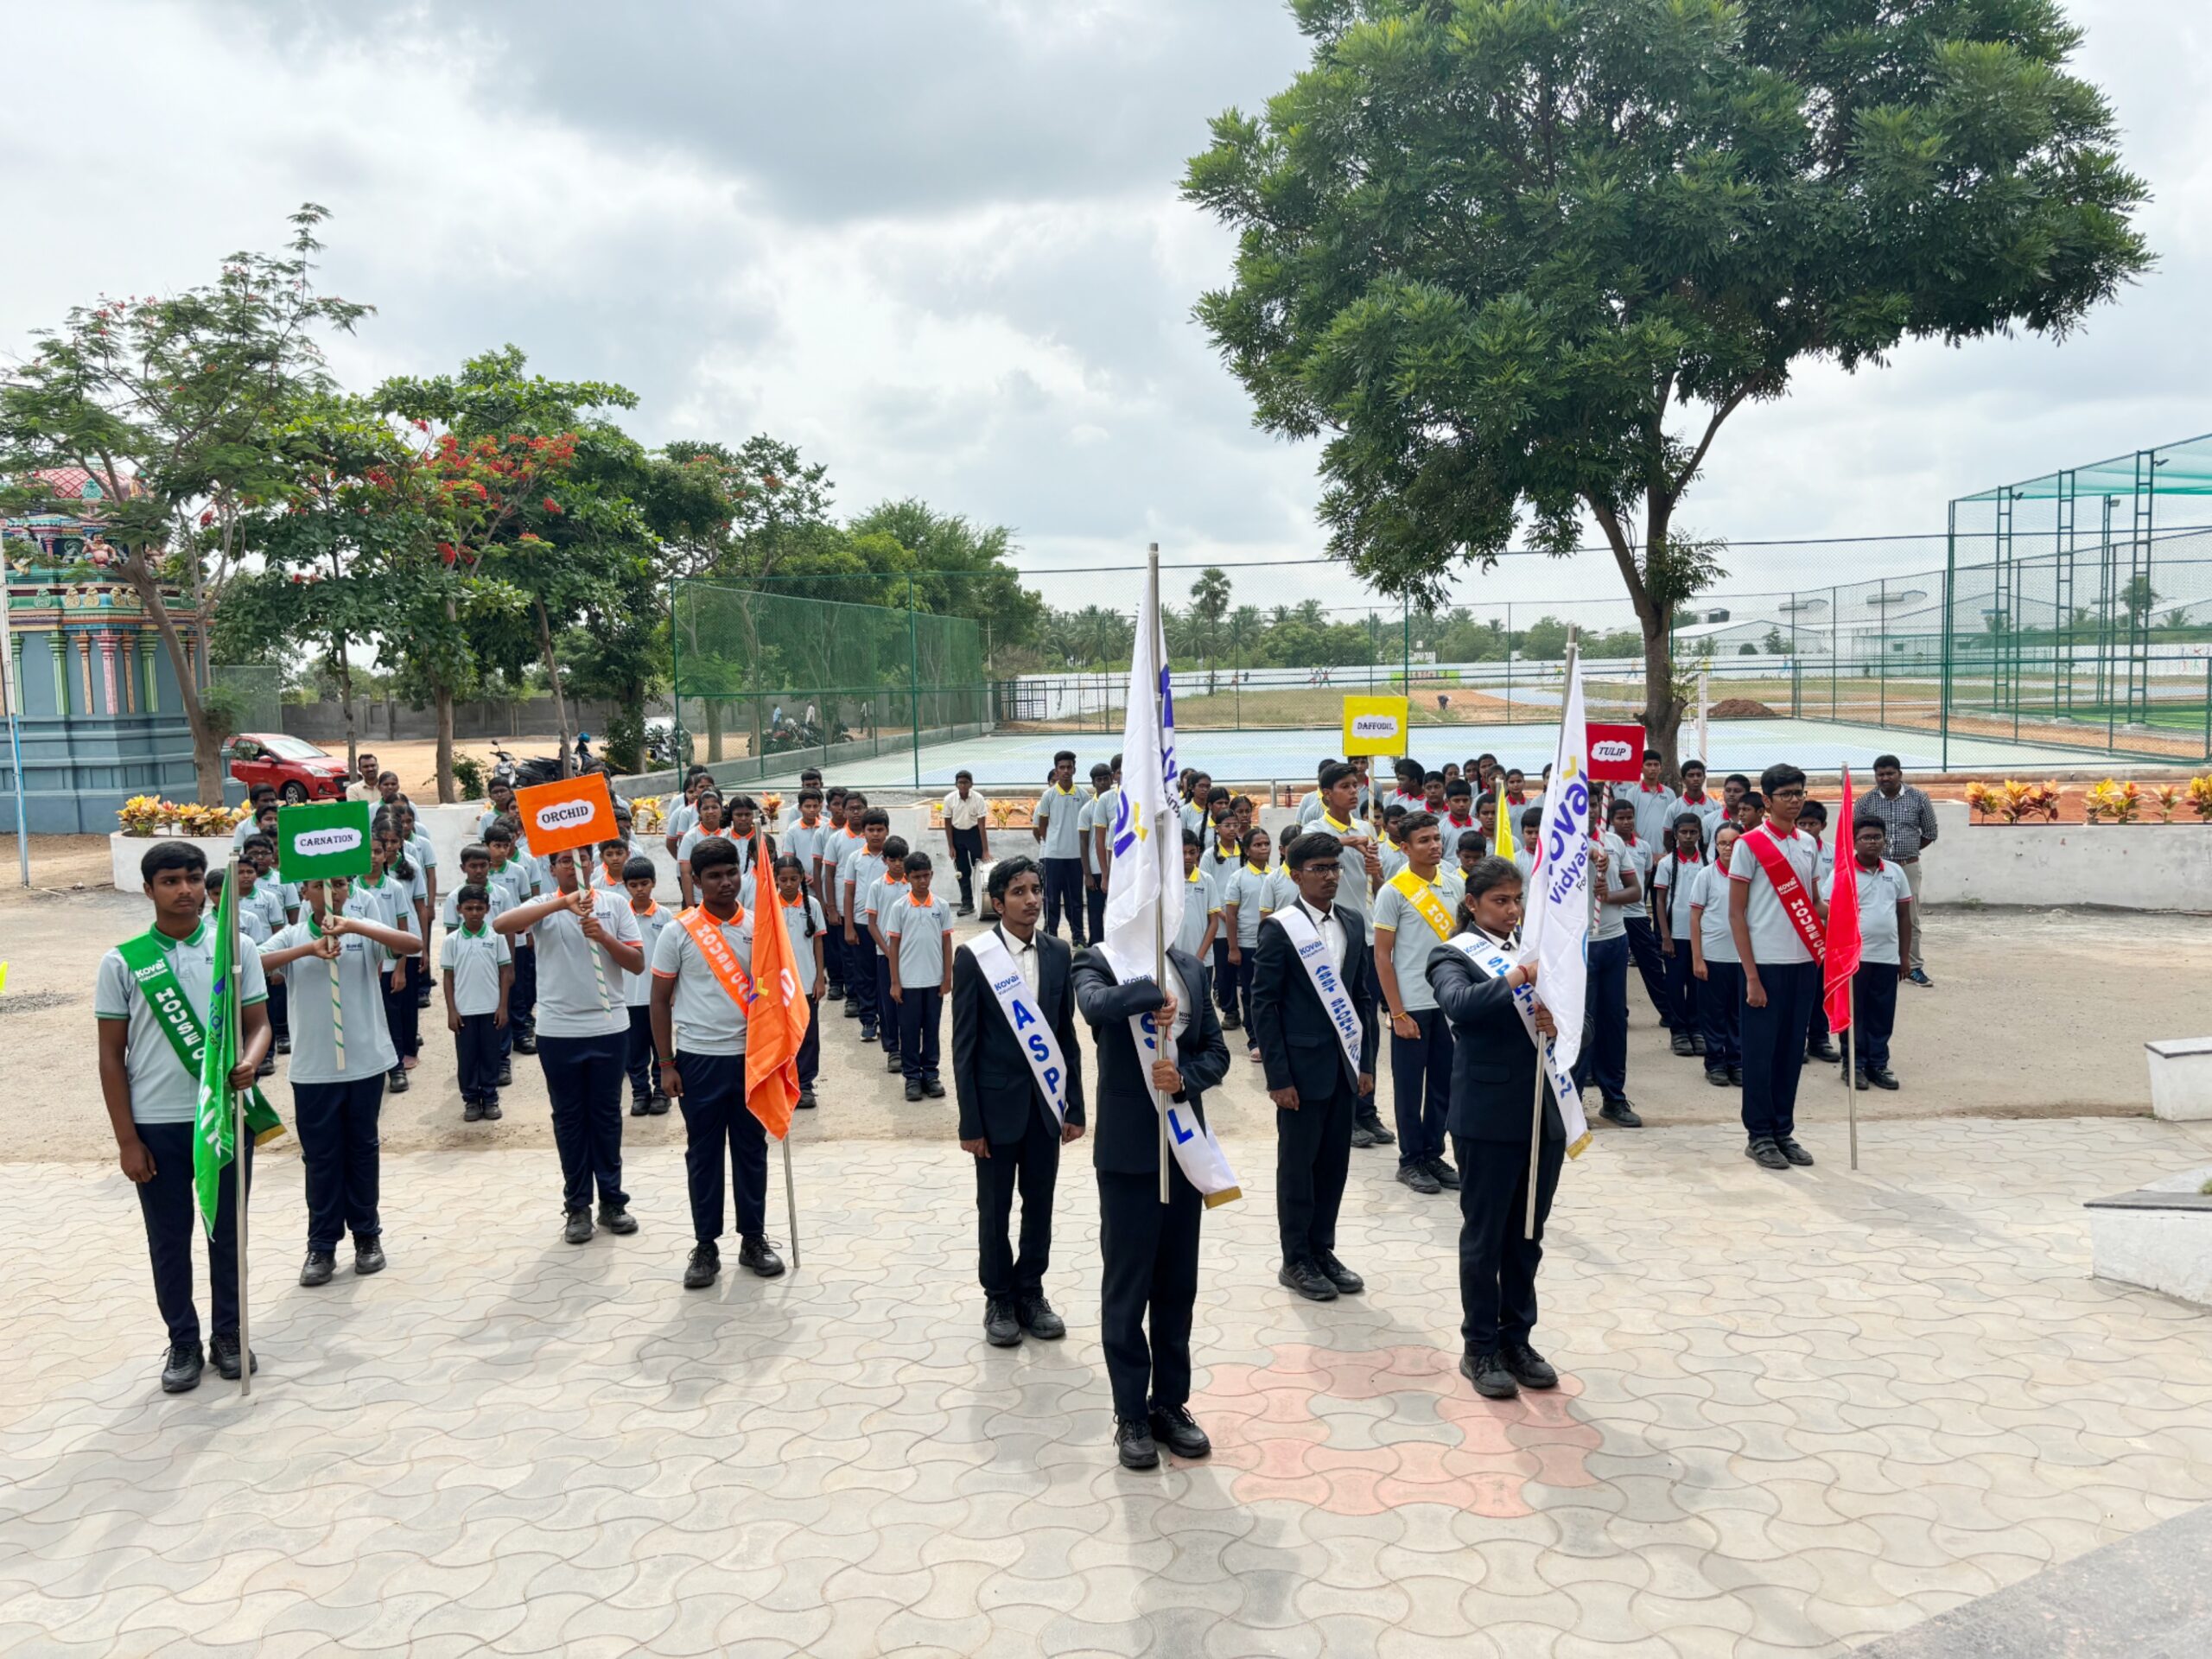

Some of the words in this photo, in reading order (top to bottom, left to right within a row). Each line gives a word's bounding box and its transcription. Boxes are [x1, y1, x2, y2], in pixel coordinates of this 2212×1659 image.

[1599, 747, 1626, 756] TULIP
[542, 806, 588, 823] ORCHID
[300, 834, 353, 847] CARNATION
[1790, 899, 1821, 940] HOUSE
[696, 924, 736, 973] HOUSE
[1299, 940, 1323, 956] Kovai
[135, 958, 167, 977] Kovai
[994, 974, 1019, 991] Kovai
[156, 987, 202, 1046] HOUSE
[1330, 997, 1358, 1039] SPORTS
